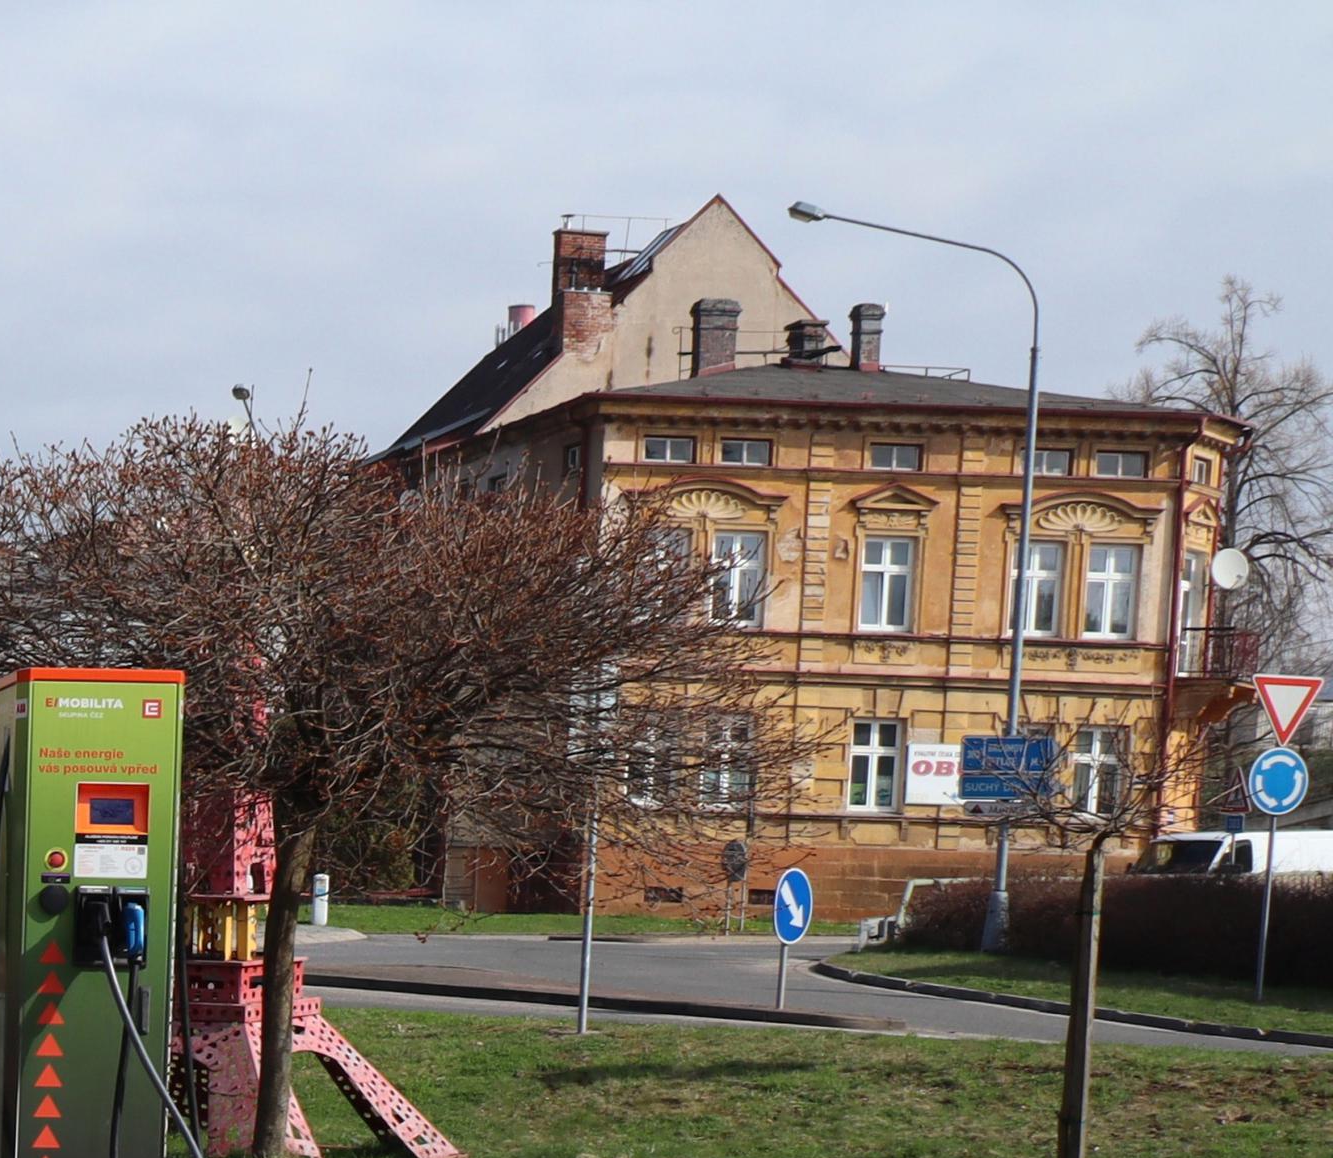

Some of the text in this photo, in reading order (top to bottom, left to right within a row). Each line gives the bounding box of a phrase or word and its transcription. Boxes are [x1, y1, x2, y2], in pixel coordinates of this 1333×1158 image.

[39, 747, 124, 761] Naše energie
[39, 761, 158, 775] vás posouvá vpřed
[911, 759, 963, 777] OB
